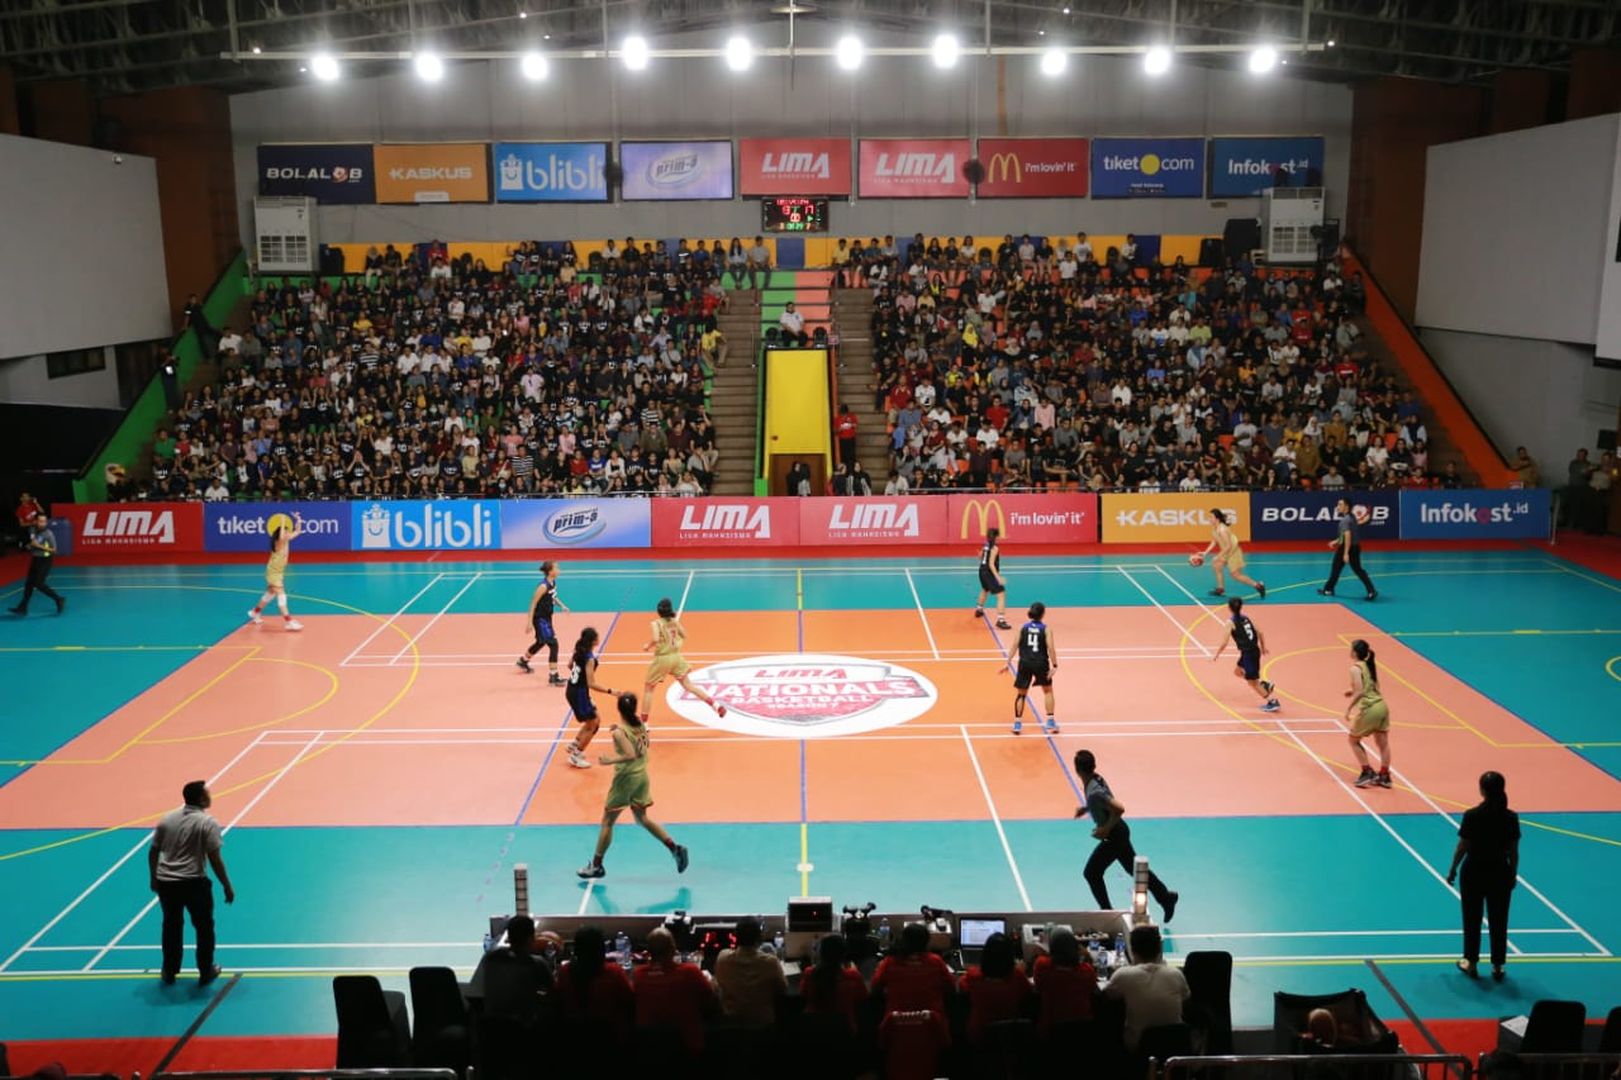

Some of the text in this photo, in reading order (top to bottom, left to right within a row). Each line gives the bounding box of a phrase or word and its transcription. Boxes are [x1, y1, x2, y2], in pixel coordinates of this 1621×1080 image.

[389, 168, 473, 181] KASKUS
[526, 154, 604, 191] blibli
[762, 153, 831, 179] LIMA
[876, 153, 955, 183] LIMA
[83, 511, 175, 543] LIMA
[395, 503, 492, 547] blibli
[680, 505, 771, 538] LIMA
[829, 504, 919, 537] LIMA
[1010, 512, 1081, 525] i'm lovin' it
[1243, 623, 1253, 640] 5
[1027, 634, 1039, 652] 4
[755, 668, 847, 679] LIMA
[686, 680, 917, 698] NATIONALS
[732, 694, 874, 705] BASKETBALL
